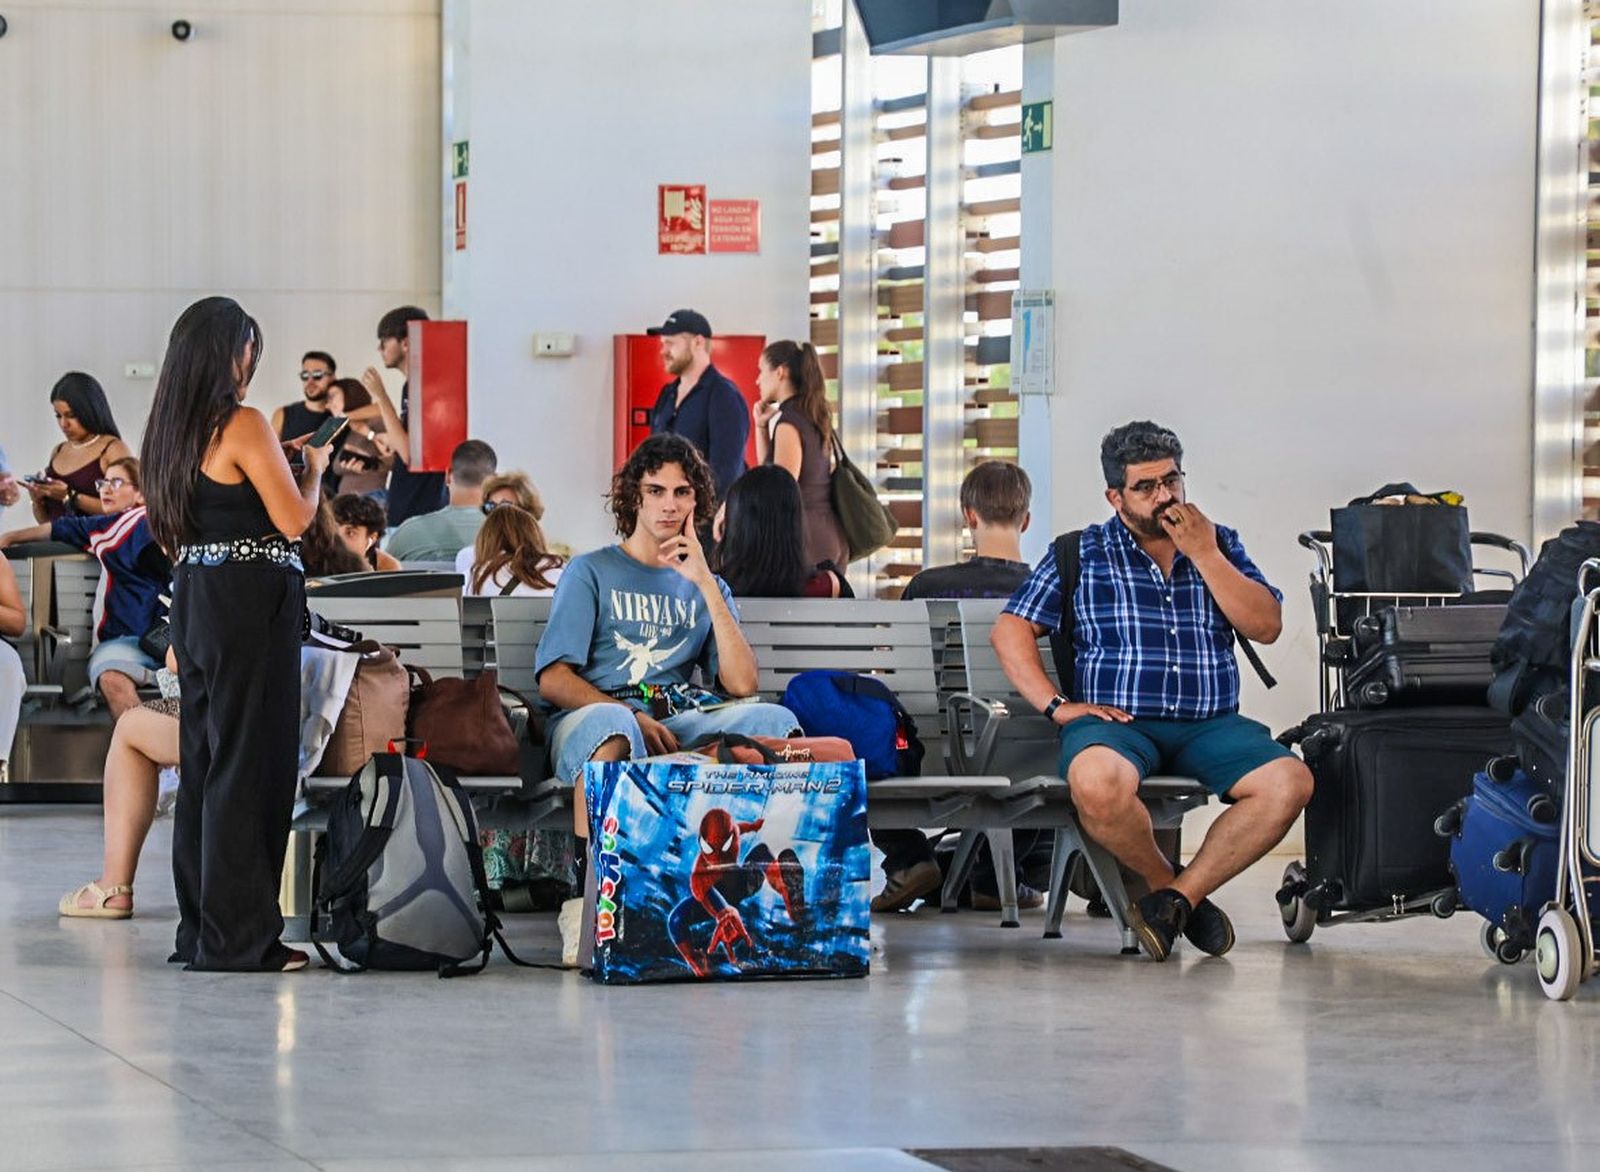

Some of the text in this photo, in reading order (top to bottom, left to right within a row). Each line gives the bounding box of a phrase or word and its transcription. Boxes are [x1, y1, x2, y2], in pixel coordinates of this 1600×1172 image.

[610, 589, 697, 629] NIRVANA
[705, 771, 738, 779] THE
[823, 778, 842, 795] 2
